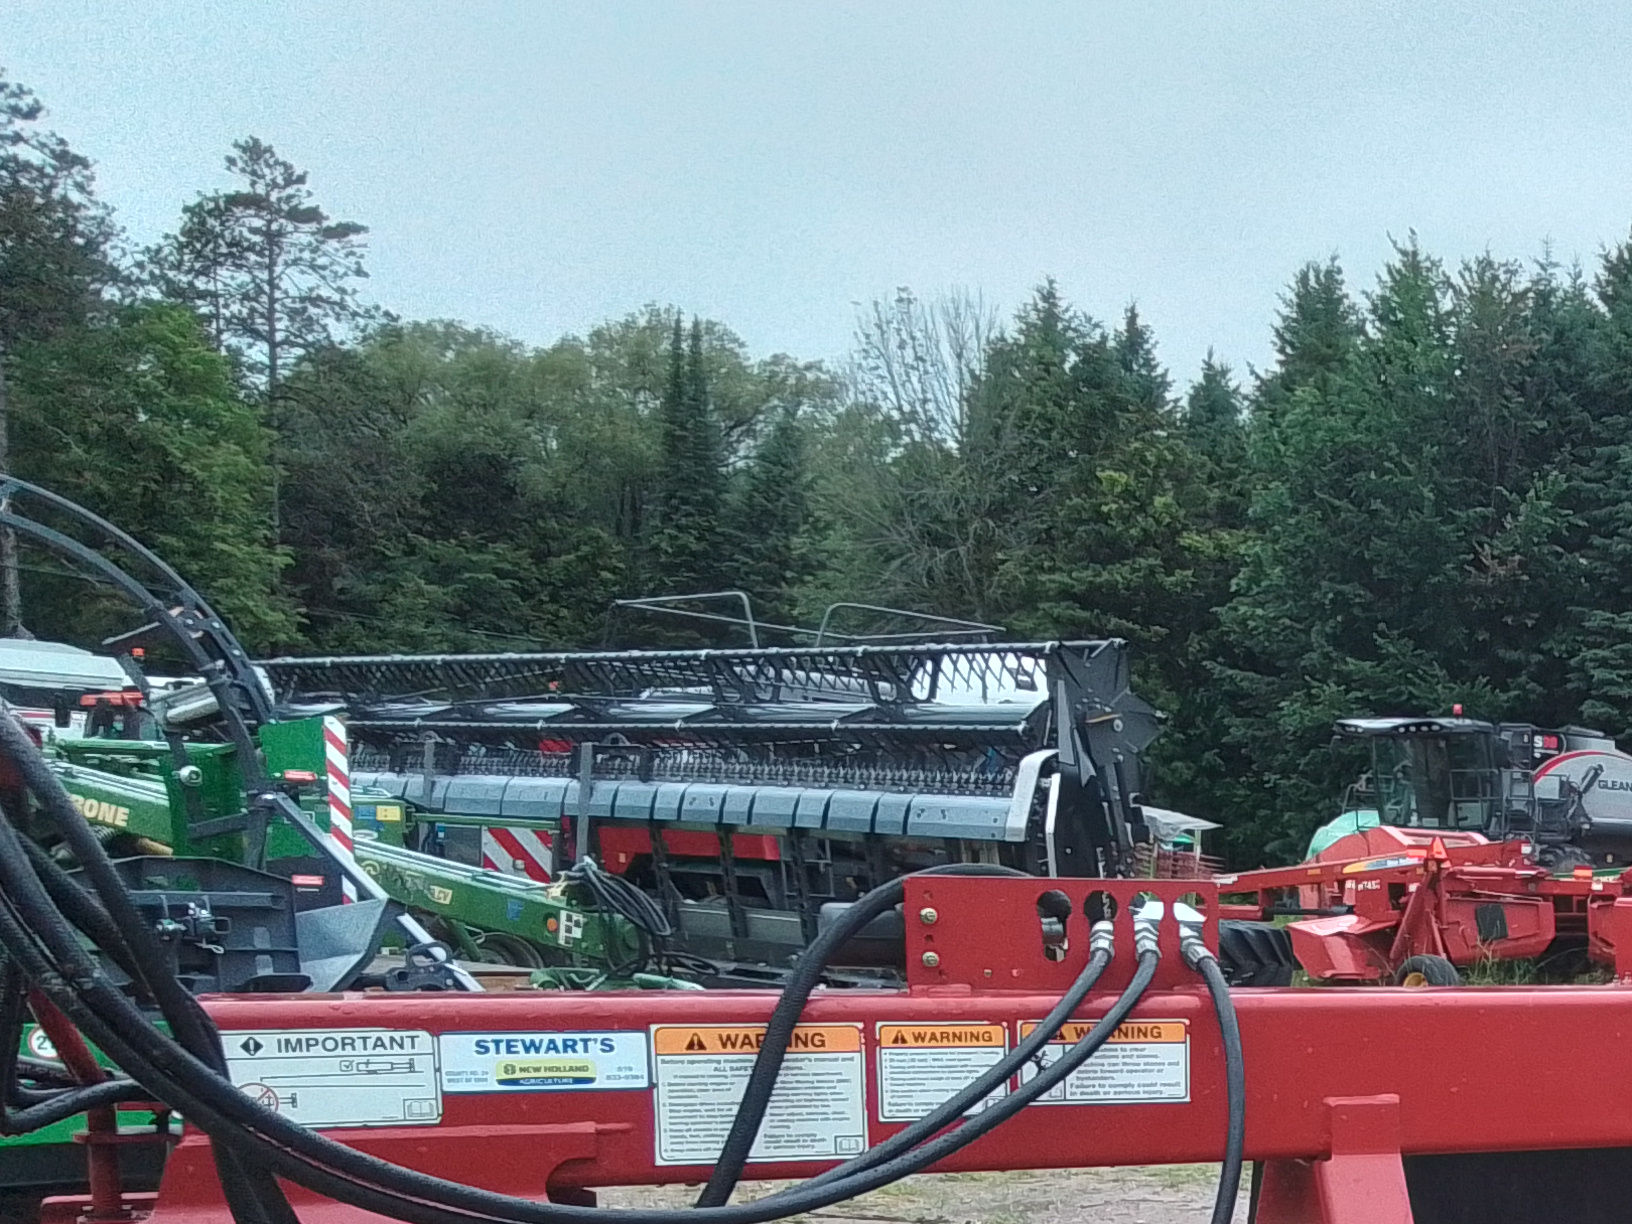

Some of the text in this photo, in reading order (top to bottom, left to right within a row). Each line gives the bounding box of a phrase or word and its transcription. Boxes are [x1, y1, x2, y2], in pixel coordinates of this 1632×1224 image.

[69, 793, 130, 827] RONE
[912, 1031, 993, 1044] WARNING
[1074, 1025, 1162, 1040] WNING
[277, 1035, 420, 1053] IMPORTANT
[474, 1037, 616, 1056] STEWART'S
[718, 1033, 826, 1049] WAING
[519, 1064, 590, 1074] NEW HOLLAND
[519, 1077, 574, 1085] AGRICULTURE
